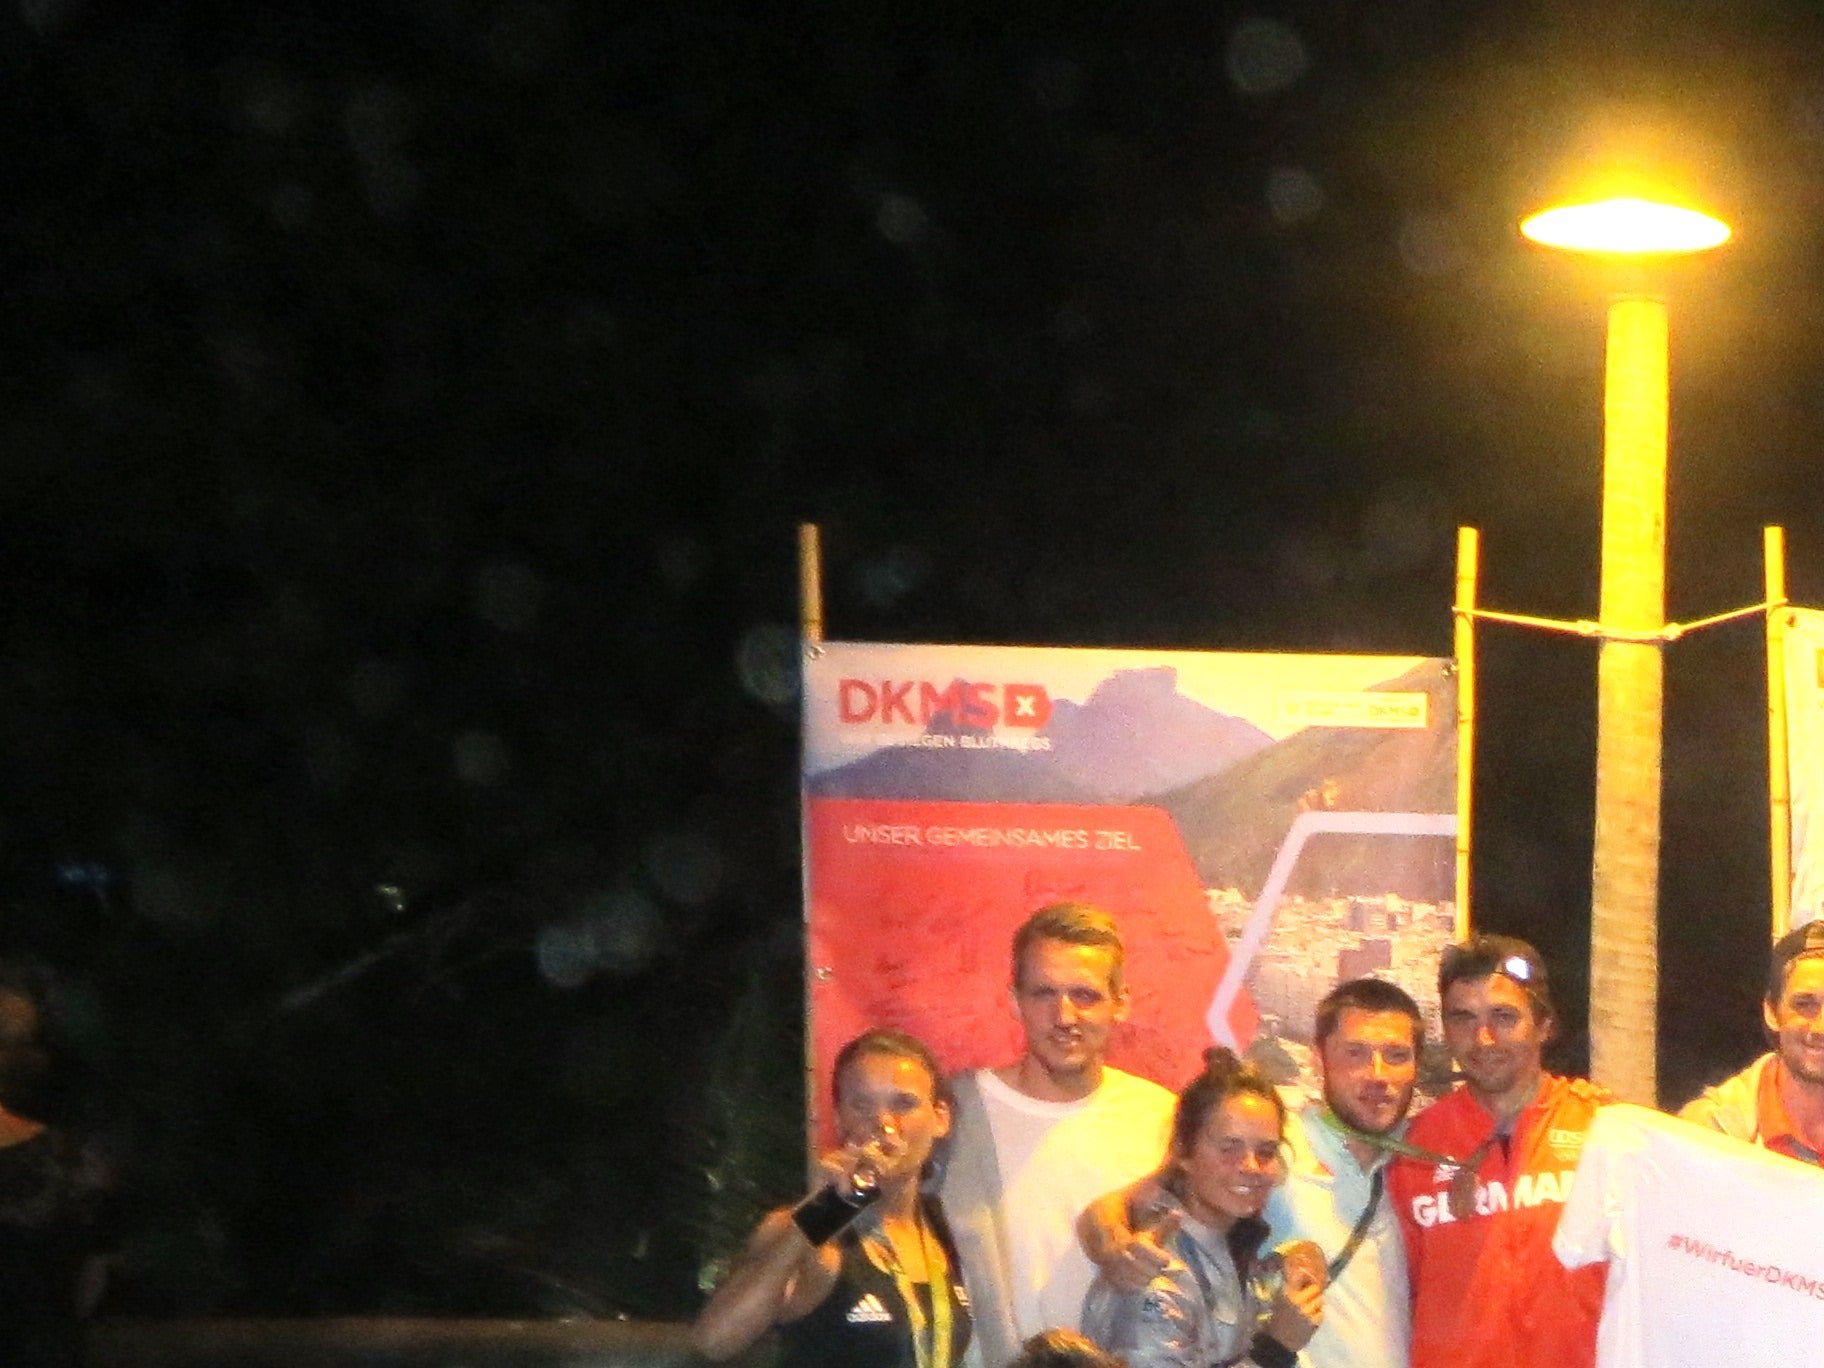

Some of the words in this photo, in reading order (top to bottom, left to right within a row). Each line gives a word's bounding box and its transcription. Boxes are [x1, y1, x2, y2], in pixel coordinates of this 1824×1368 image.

[838, 678, 1000, 729] DKMS
[843, 824, 921, 847] UNSER
[926, 825, 1088, 849] GEMEINSAMES
[1095, 830, 1142, 850] ZIEL
